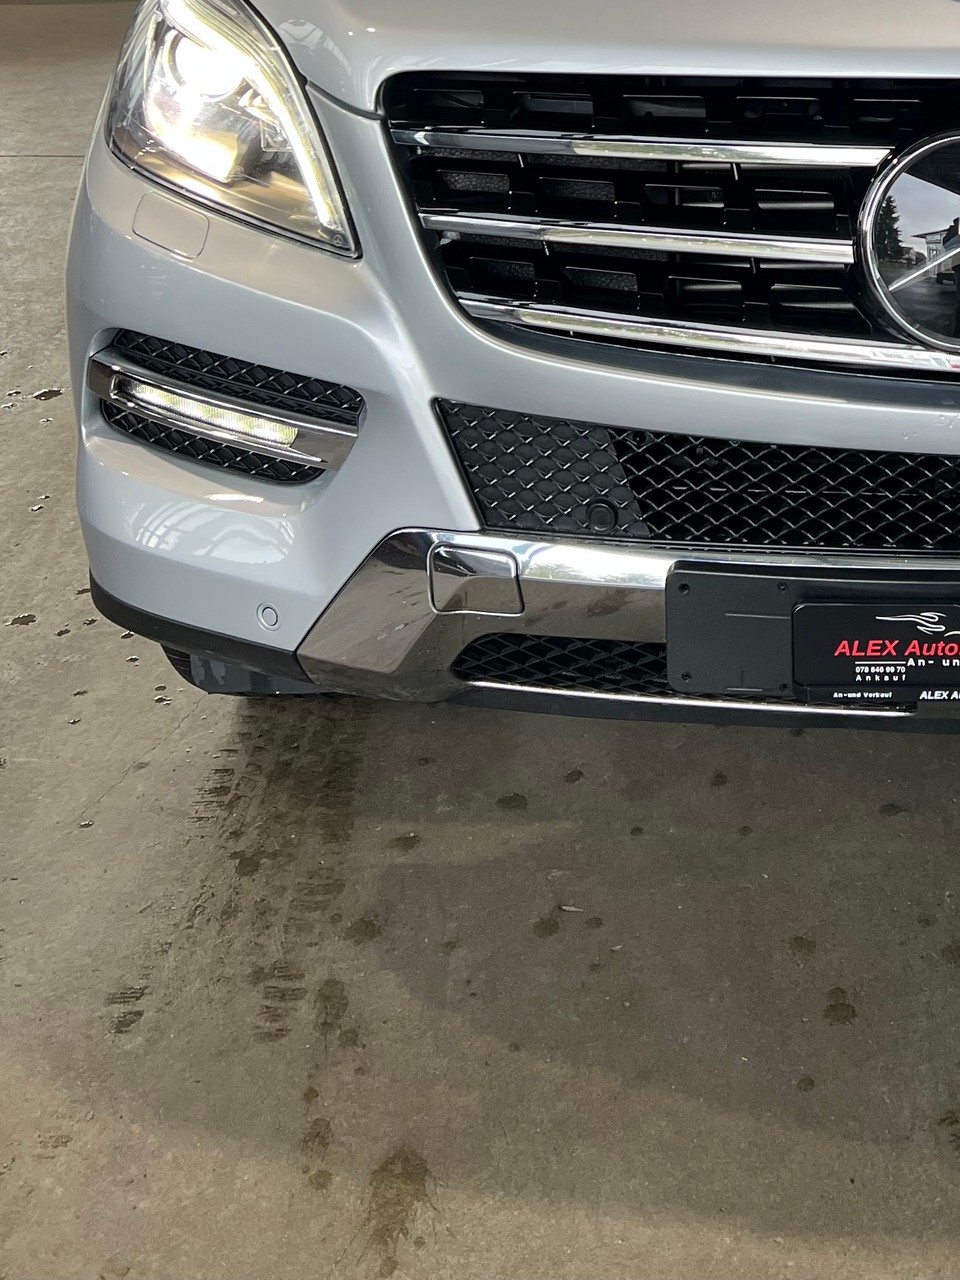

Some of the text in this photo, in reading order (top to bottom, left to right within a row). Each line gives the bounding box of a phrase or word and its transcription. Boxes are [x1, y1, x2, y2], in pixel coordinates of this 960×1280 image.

[834, 640, 899, 656] ALEX
[907, 658, 935, 667] An-
[919, 691, 949, 700] ALEX
